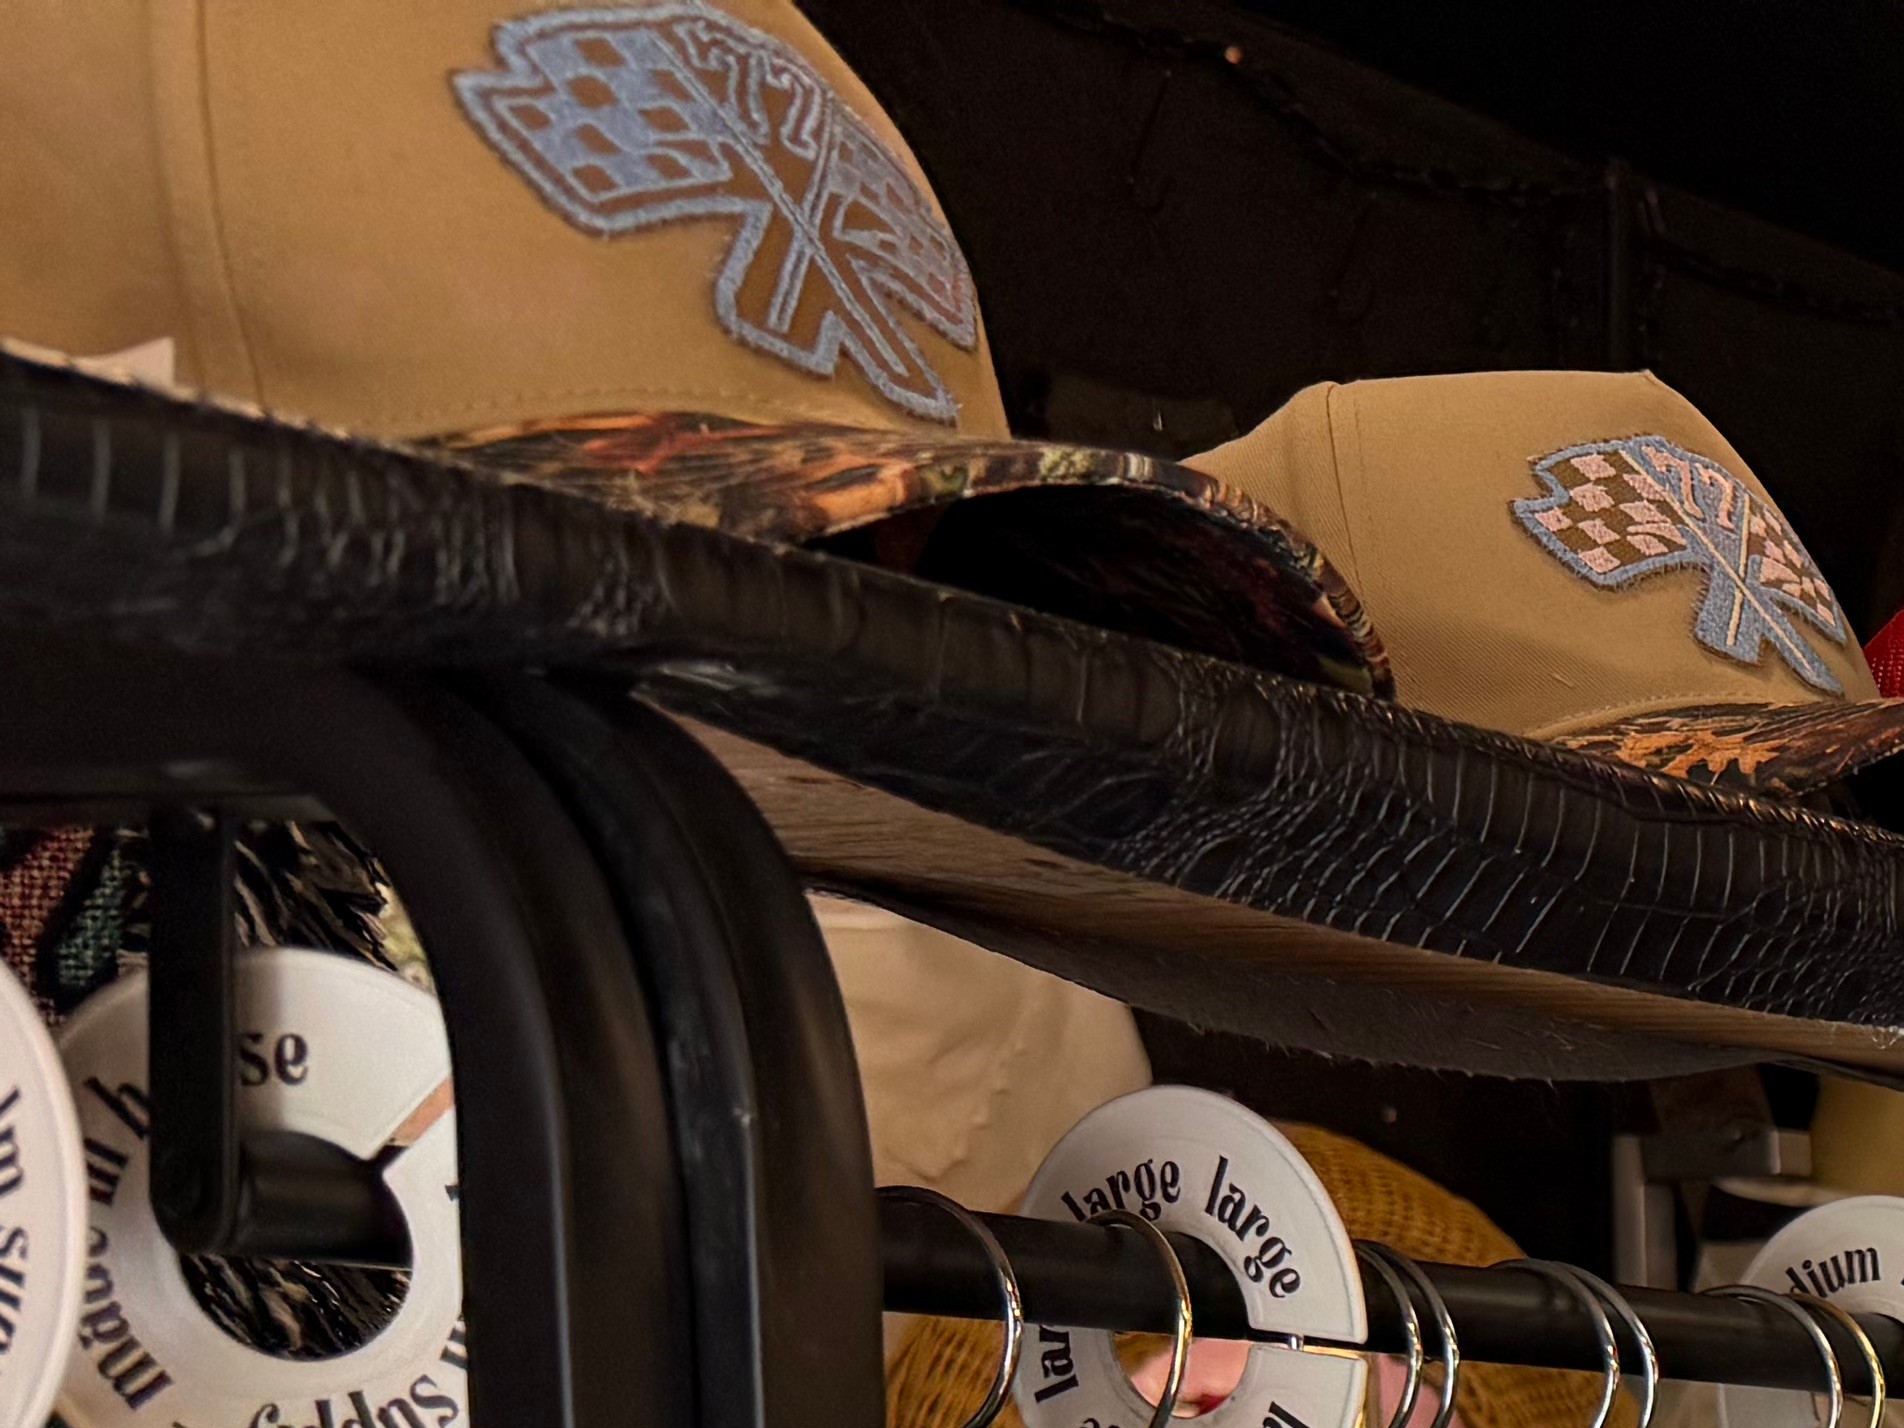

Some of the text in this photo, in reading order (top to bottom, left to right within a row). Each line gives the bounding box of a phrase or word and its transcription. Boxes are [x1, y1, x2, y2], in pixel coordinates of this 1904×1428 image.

[1641, 446, 1737, 531] 77
[1034, 1324, 1079, 1404] lar
[1061, 1158, 1181, 1223] large
[1205, 1155, 1301, 1300] large
[1785, 1247, 1881, 1298] dium
